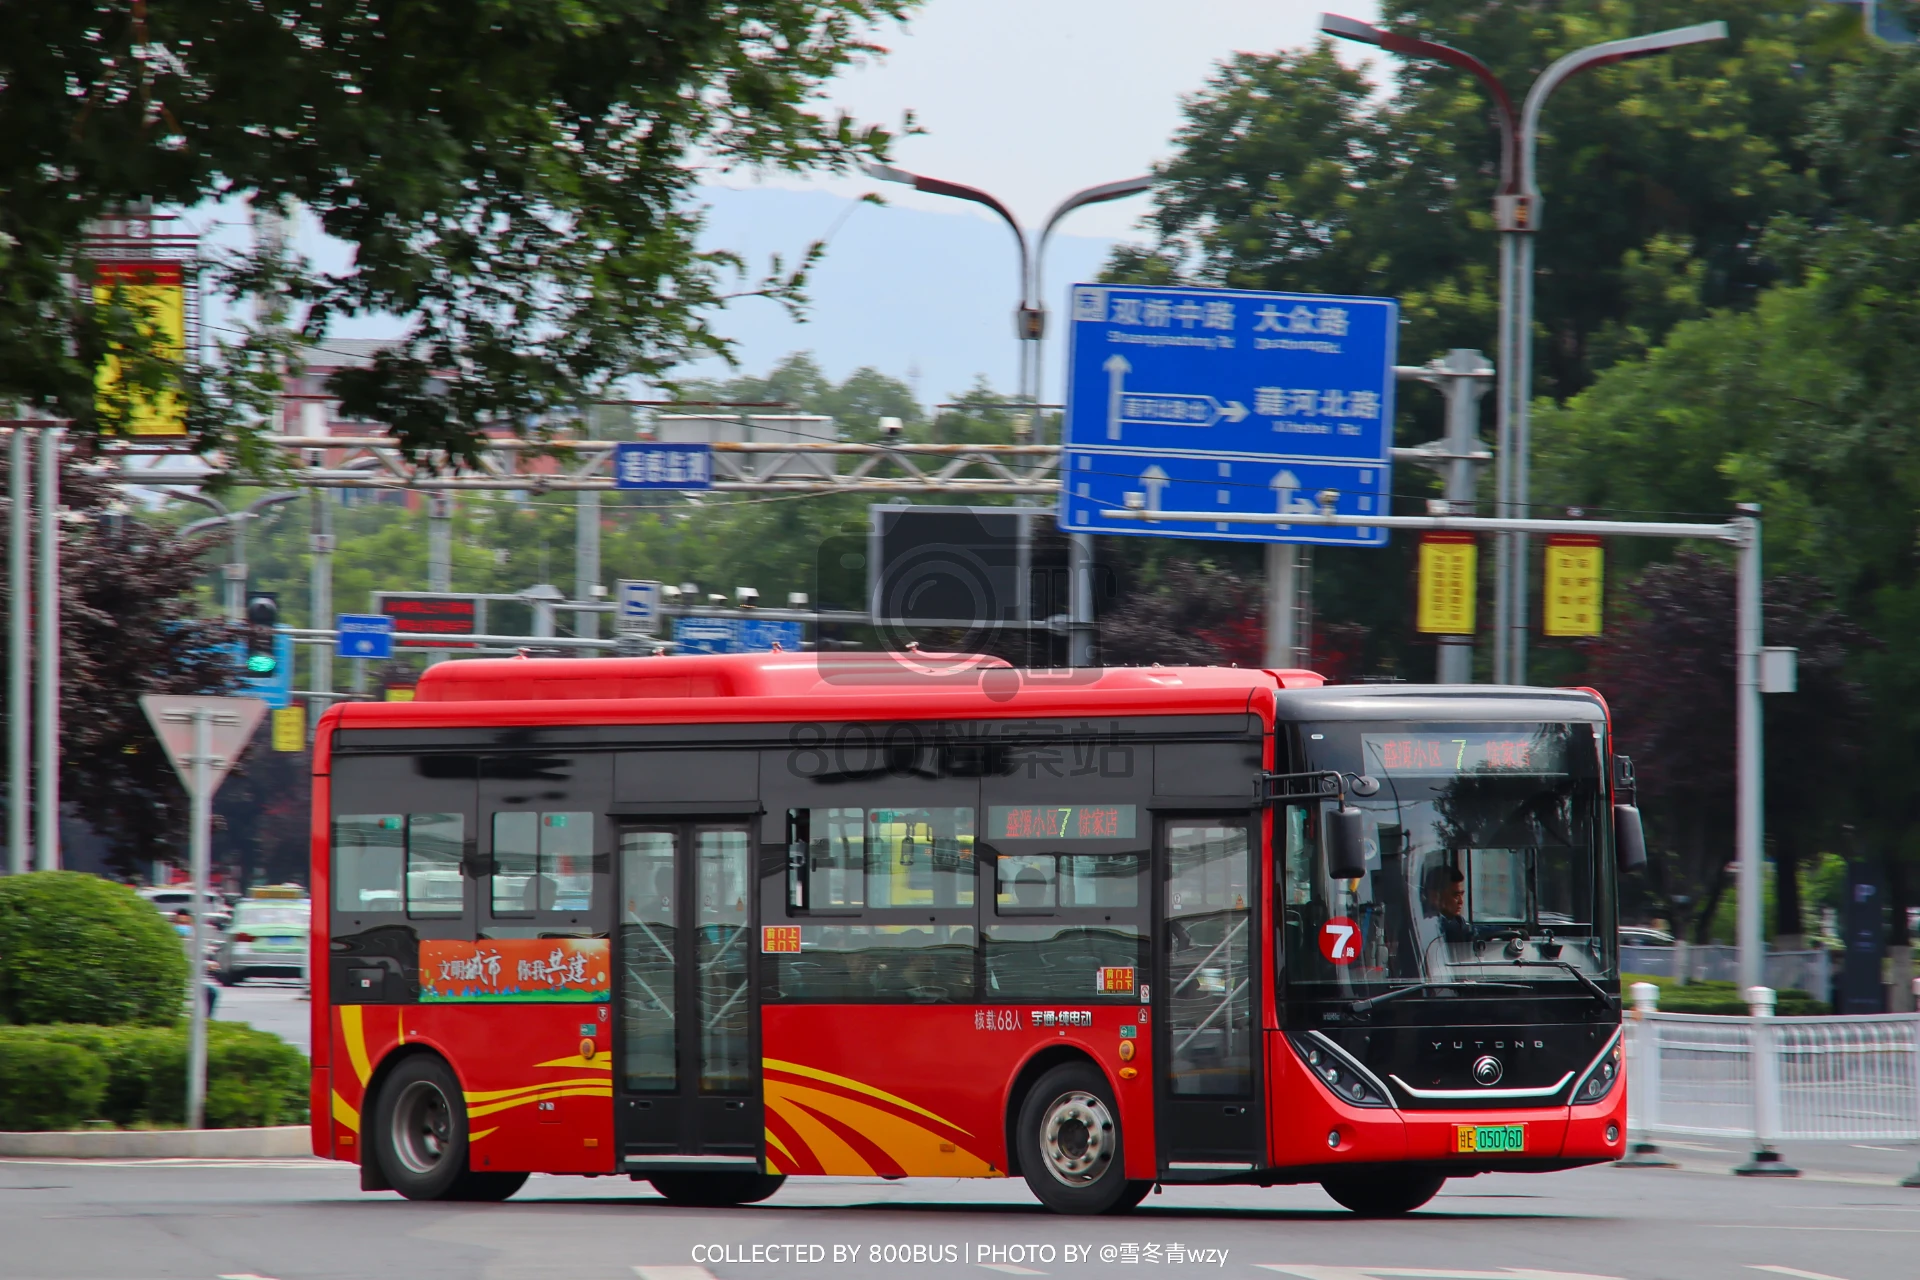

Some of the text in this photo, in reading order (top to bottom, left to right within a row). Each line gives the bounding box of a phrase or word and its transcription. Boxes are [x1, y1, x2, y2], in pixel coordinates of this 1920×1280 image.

[1111, 298, 1236, 330] 双桥中路
[1253, 304, 1349, 336] 大众路
[1452, 739, 1467, 769] 7
[1005, 808, 1118, 837] 盛源小区 7 徐家店
[766, 927, 798, 940] 前门上
[766, 940, 798, 952] 后门下
[437, 947, 588, 987] 文明城市 你我共建
[1106, 968, 1132, 979] 前门上
[1106, 980, 1132, 990] 后门下
[974, 1009, 1023, 1031] 核载68人
[1431, 1040, 1544, 1050] YUTONG
